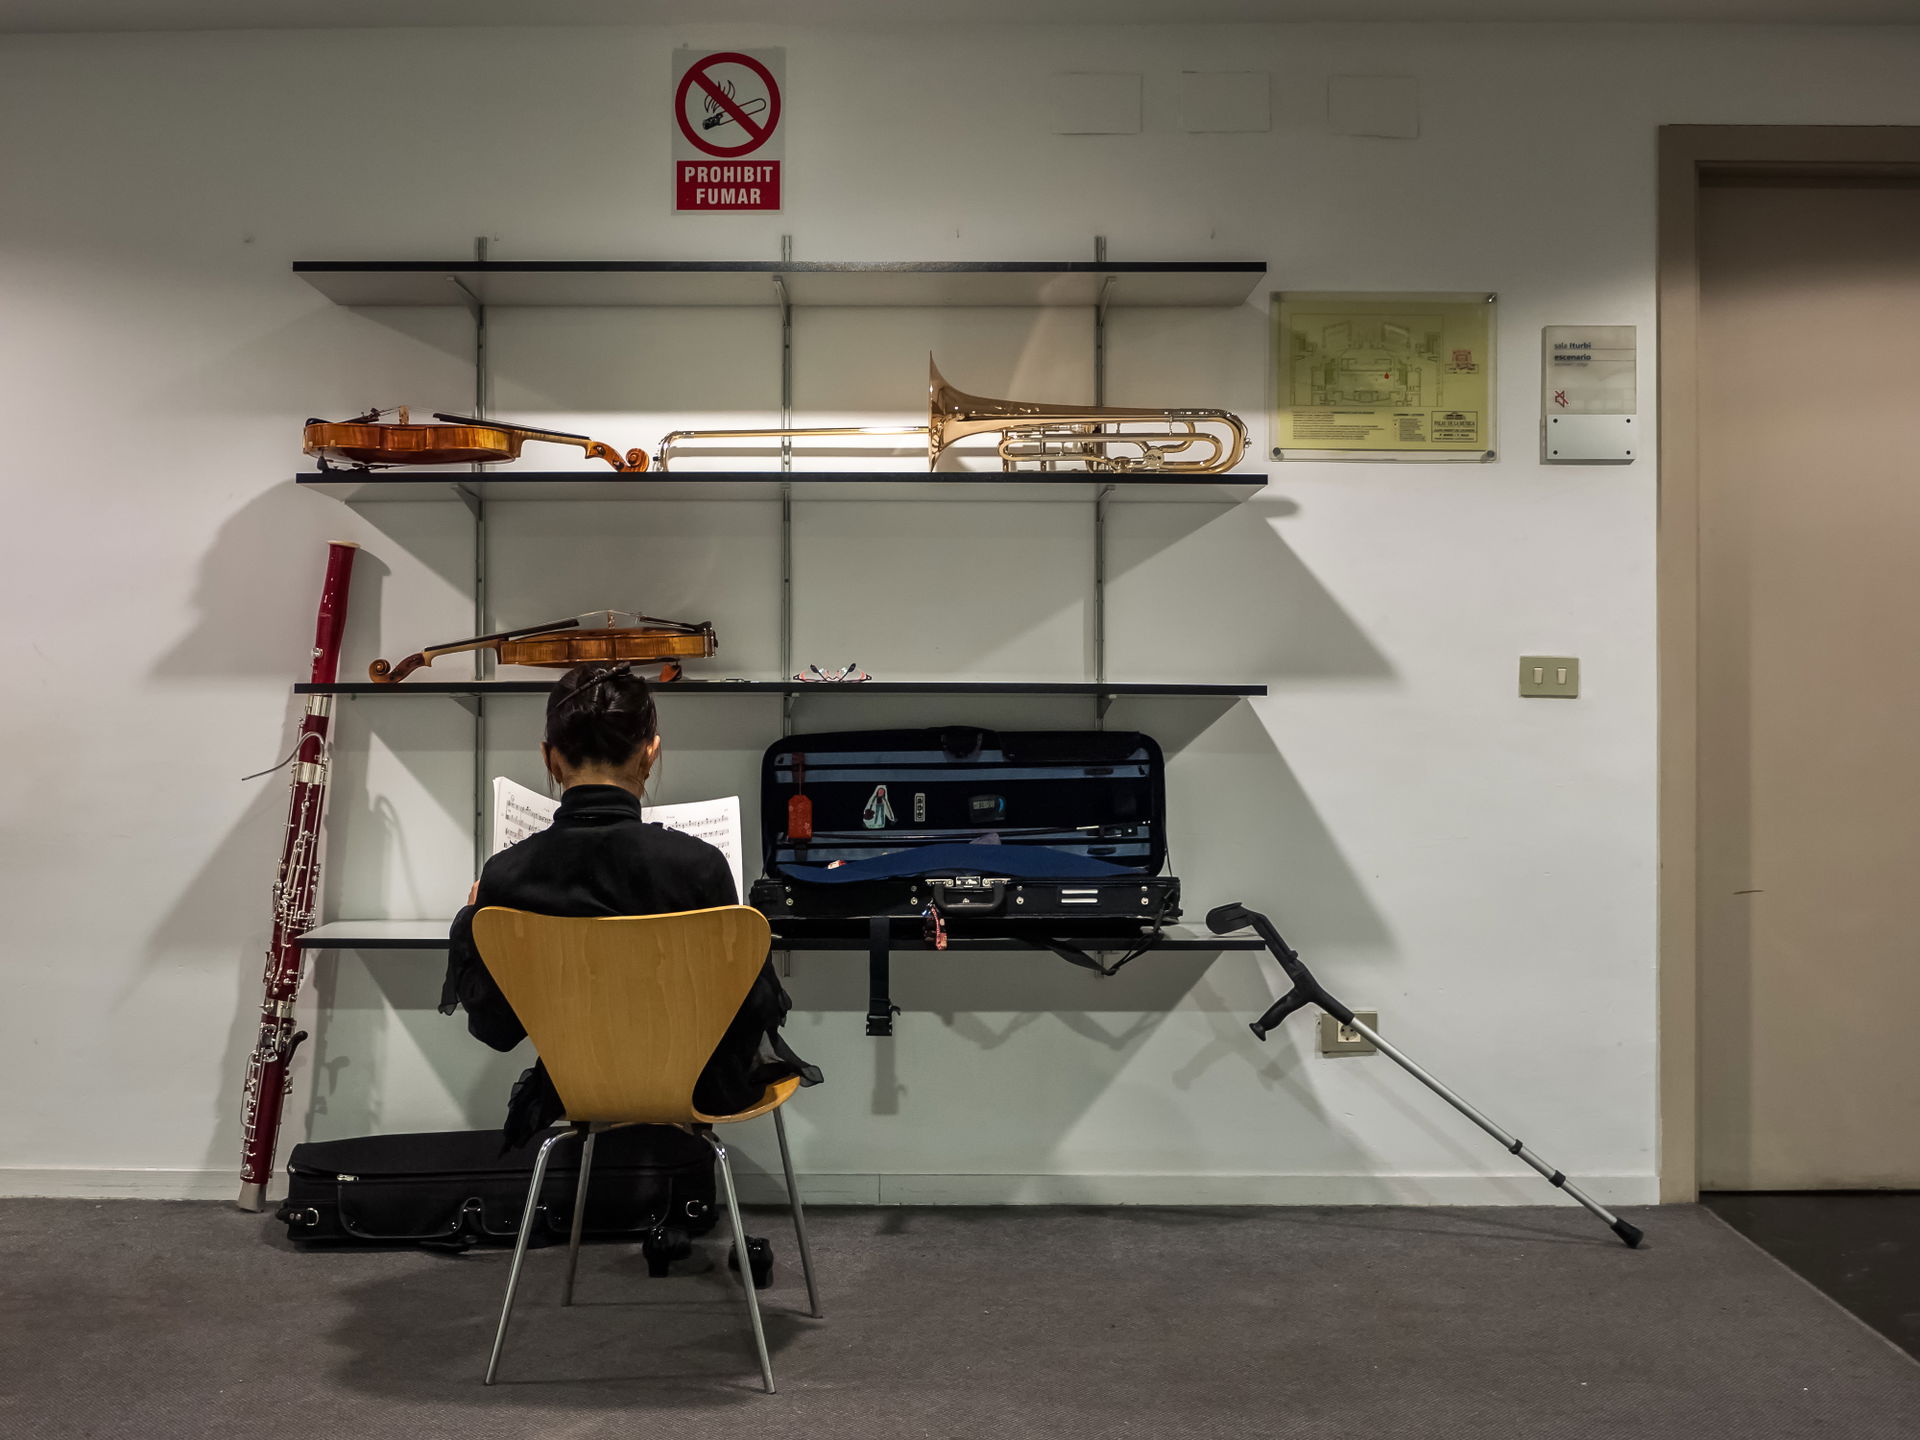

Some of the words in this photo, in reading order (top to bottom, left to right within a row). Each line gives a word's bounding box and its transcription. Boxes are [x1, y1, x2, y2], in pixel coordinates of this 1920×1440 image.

[684, 166, 774, 183] PROHIBIT
[696, 187, 761, 205] FUMAR
[1554, 342, 1568, 350] sala
[1569, 342, 1592, 350] Iturbi
[1554, 353, 1592, 361] escenario
